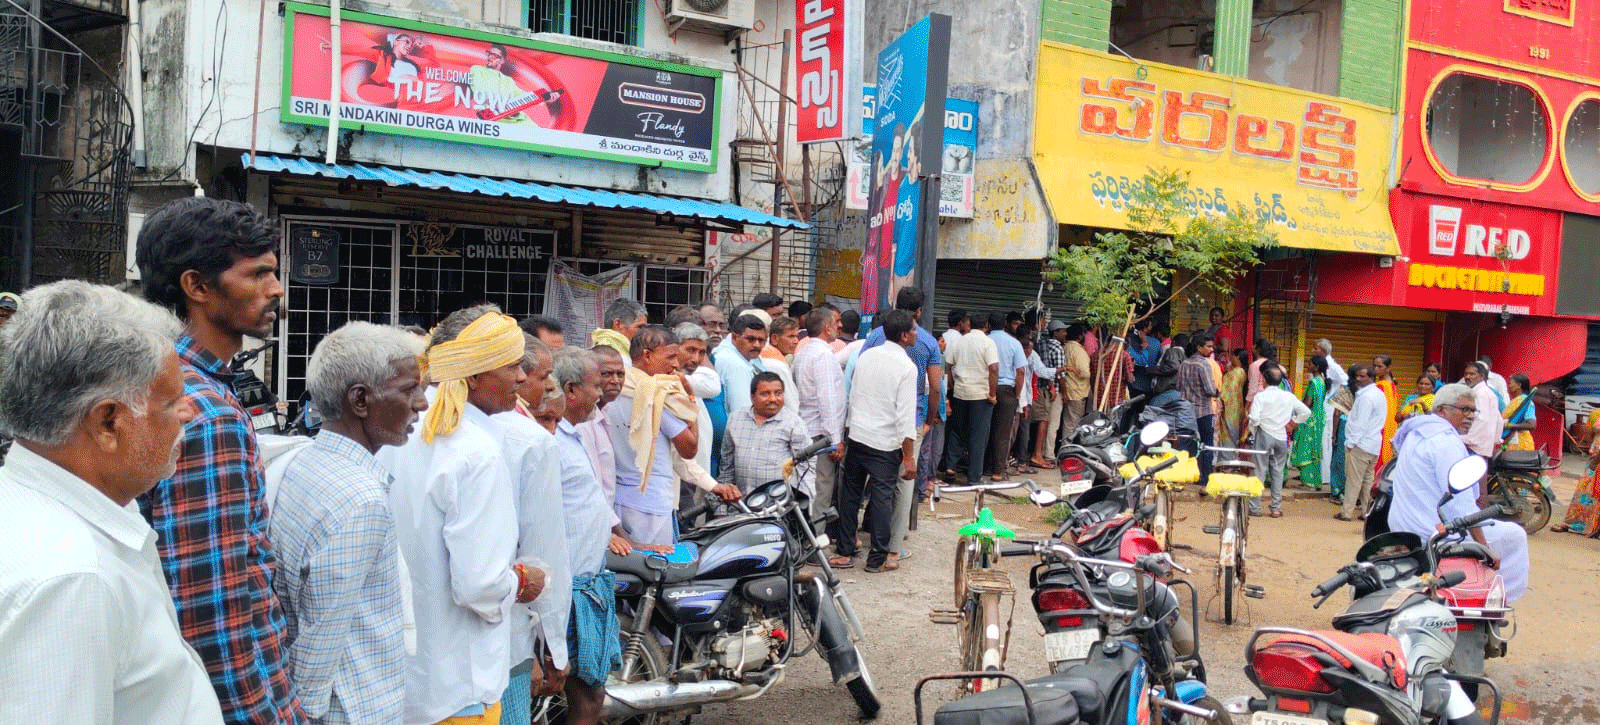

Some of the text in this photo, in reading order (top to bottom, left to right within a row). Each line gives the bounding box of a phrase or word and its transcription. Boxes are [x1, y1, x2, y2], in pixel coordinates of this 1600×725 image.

[426, 66, 474, 85] WELCOME
[389, 77, 442, 104] THE
[623, 88, 702, 107] MANSION HOUSE
[294, 100, 319, 115] SRI
[406, 113, 454, 132] DURGA
[457, 121, 501, 137] WINES
[637, 112, 685, 138] Flandy
[484, 227, 526, 243] ROYAL
[1437, 231, 1454, 241] RED
[1463, 223, 1531, 260] RED
[308, 250, 323, 261] B7
[466, 244, 543, 260] CHALLENGE
